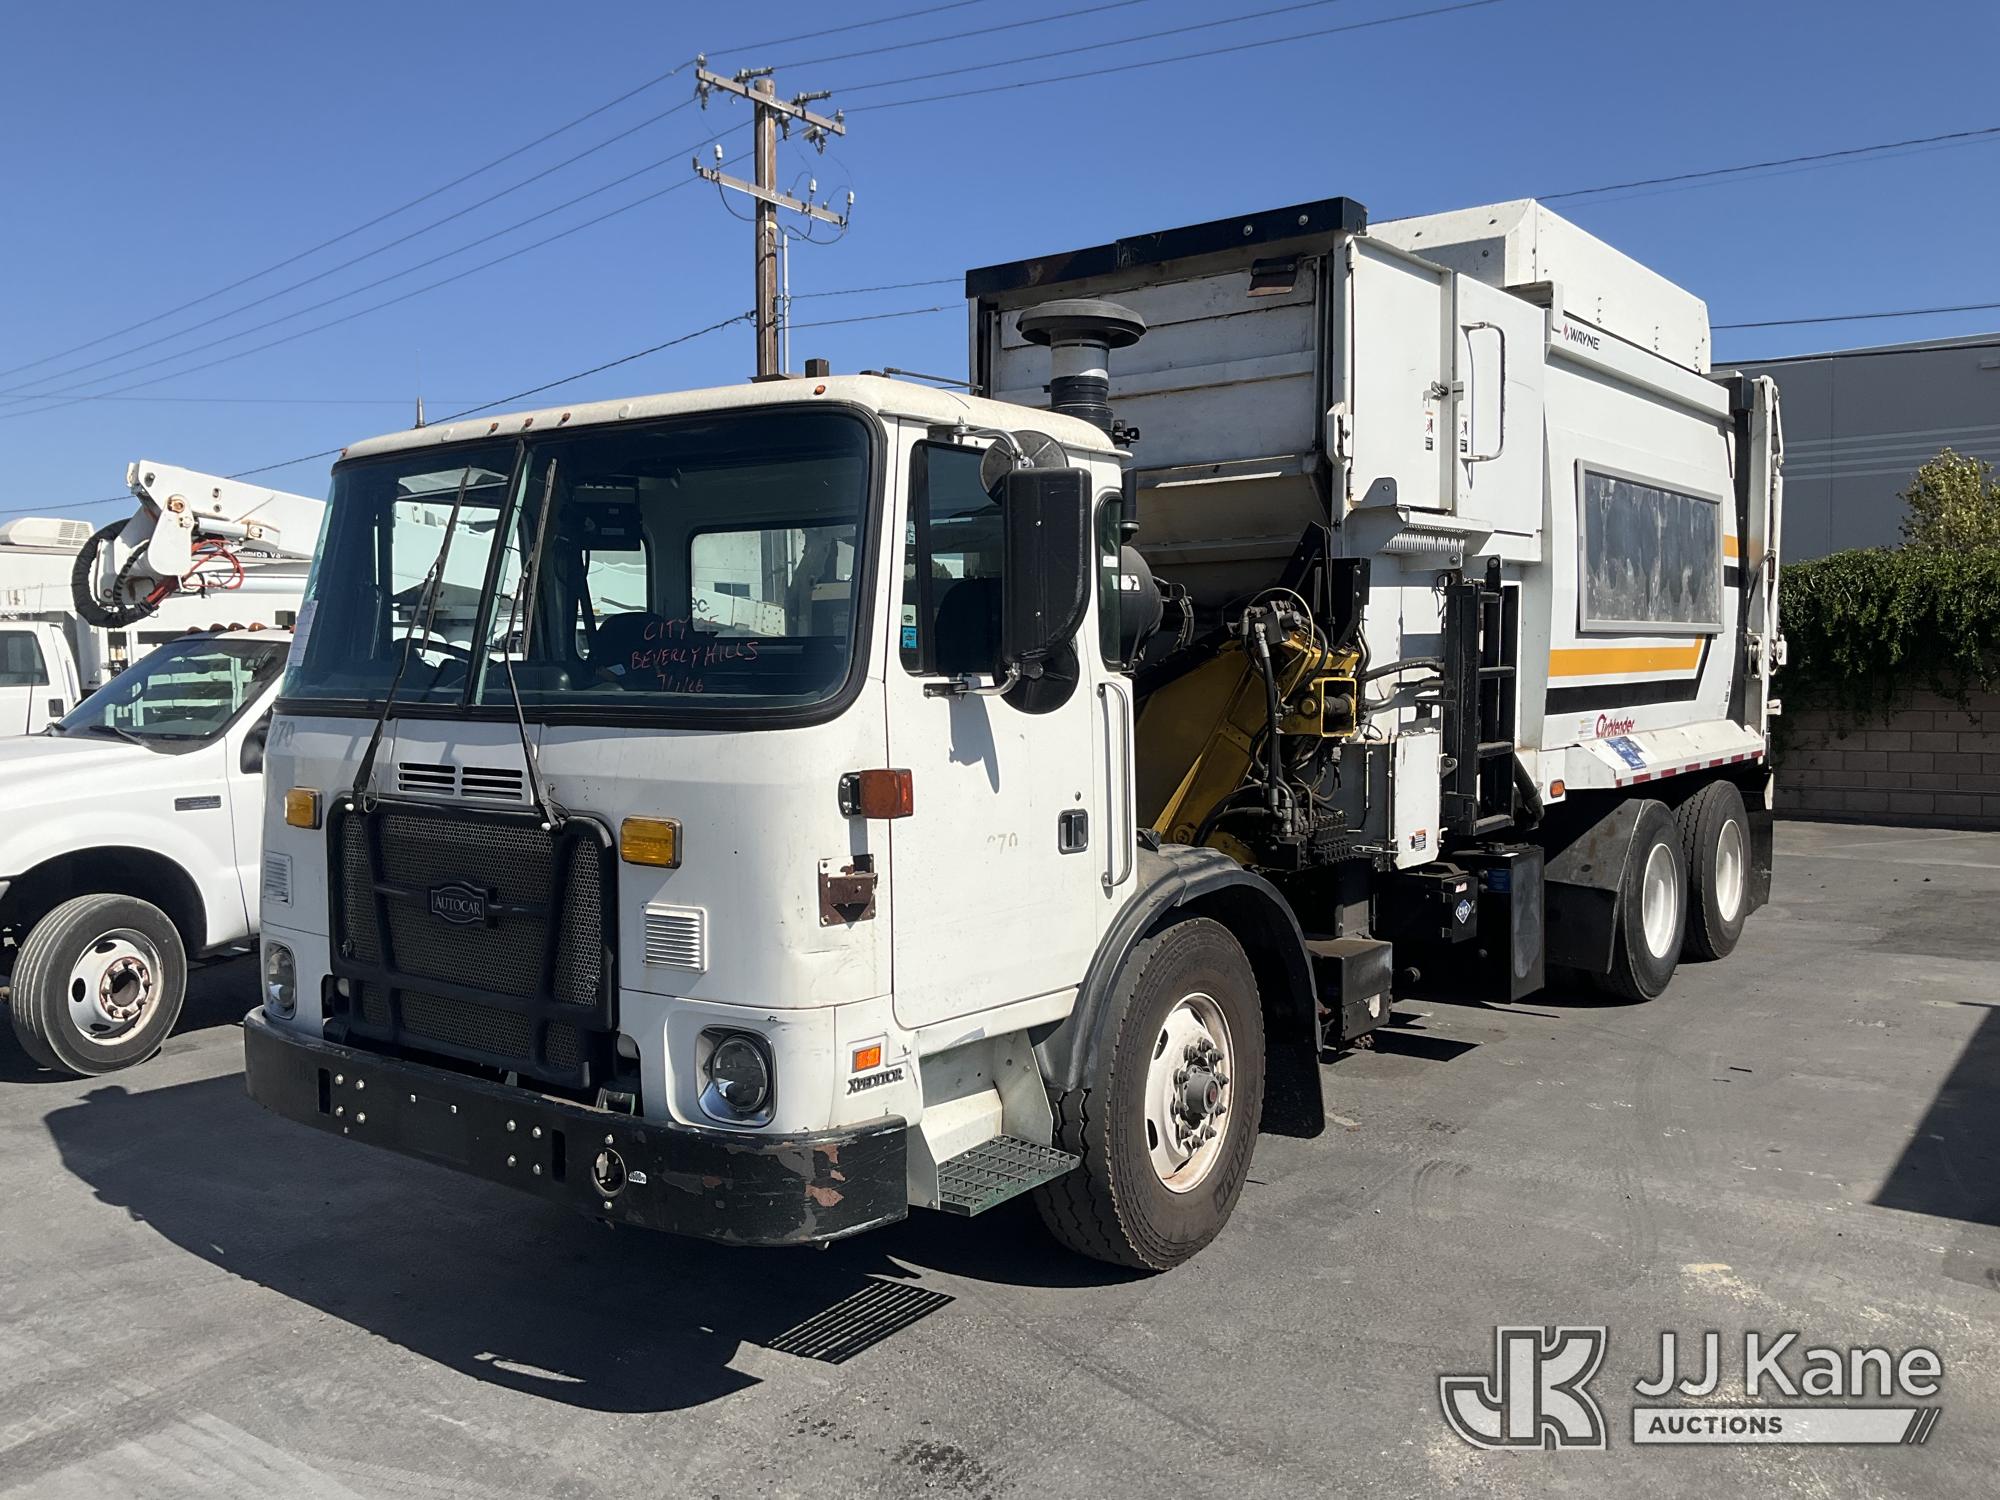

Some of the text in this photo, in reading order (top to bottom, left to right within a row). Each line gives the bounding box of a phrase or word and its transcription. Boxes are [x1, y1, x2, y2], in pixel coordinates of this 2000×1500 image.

[1570, 327, 1600, 350] WAYNE
[644, 615, 690, 640] CITY
[631, 641, 759, 670] BEVERLY HILLS
[435, 895, 481, 917] AUTOCAR
[846, 1068, 904, 1095] XPEDITOR
